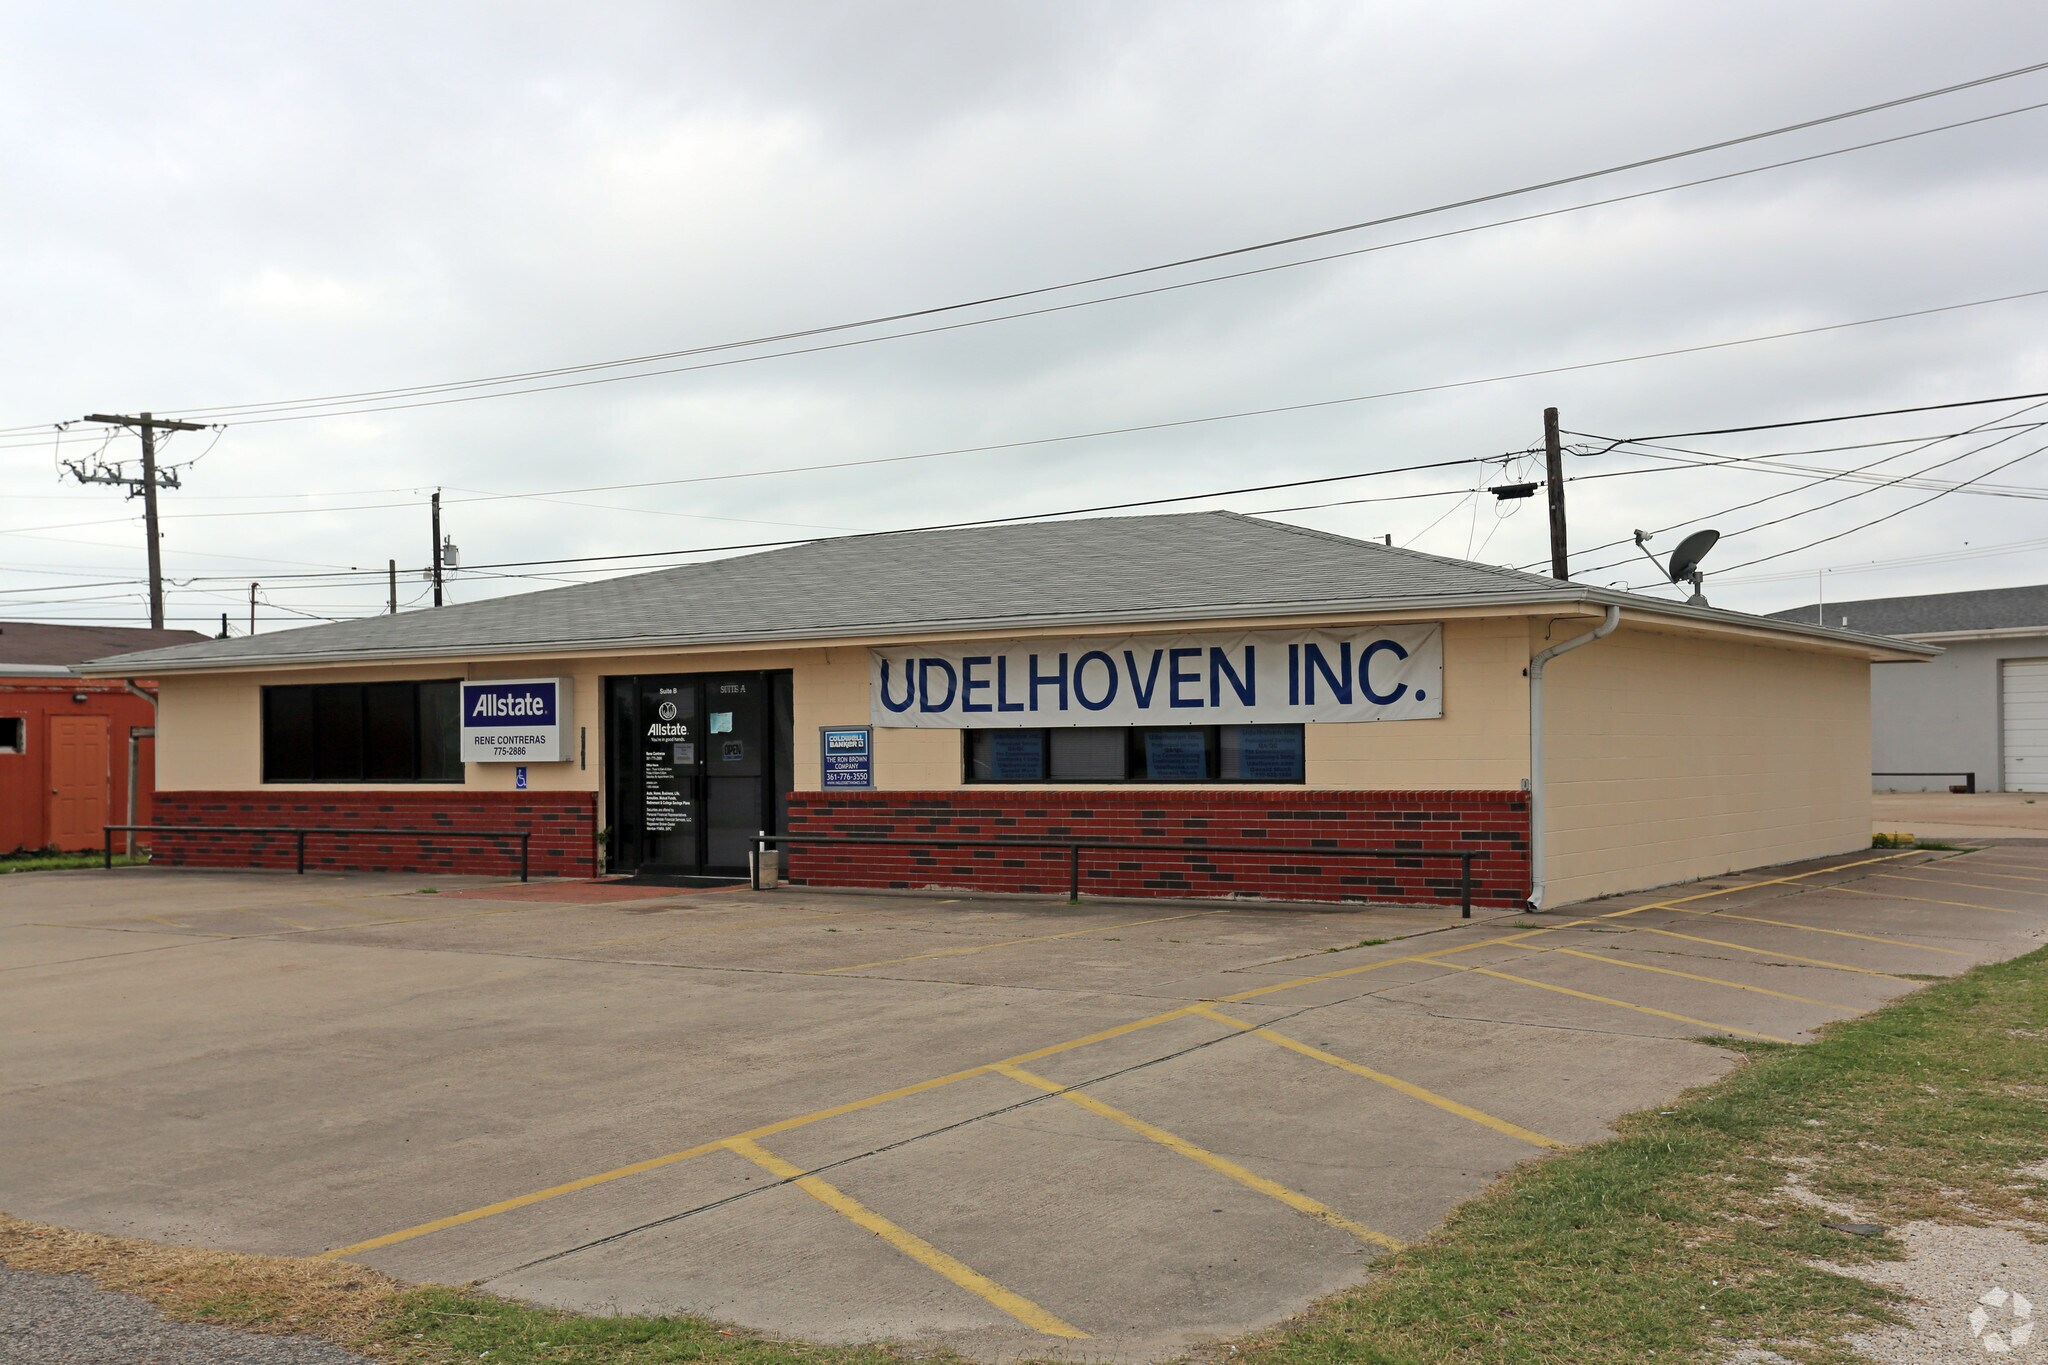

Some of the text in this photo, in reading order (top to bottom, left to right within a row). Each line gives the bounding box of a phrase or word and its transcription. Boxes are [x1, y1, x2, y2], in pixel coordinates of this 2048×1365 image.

[880, 639, 1427, 713] UDELHOVEN INC.
[740, 684, 746, 693] A
[472, 692, 544, 717] Allstate
[647, 723, 687, 736] Allstate
[474, 735, 546, 745] RENE CONTRERAS
[494, 747, 526, 756] 775-2886
[724, 744, 742, 755] OPEN
